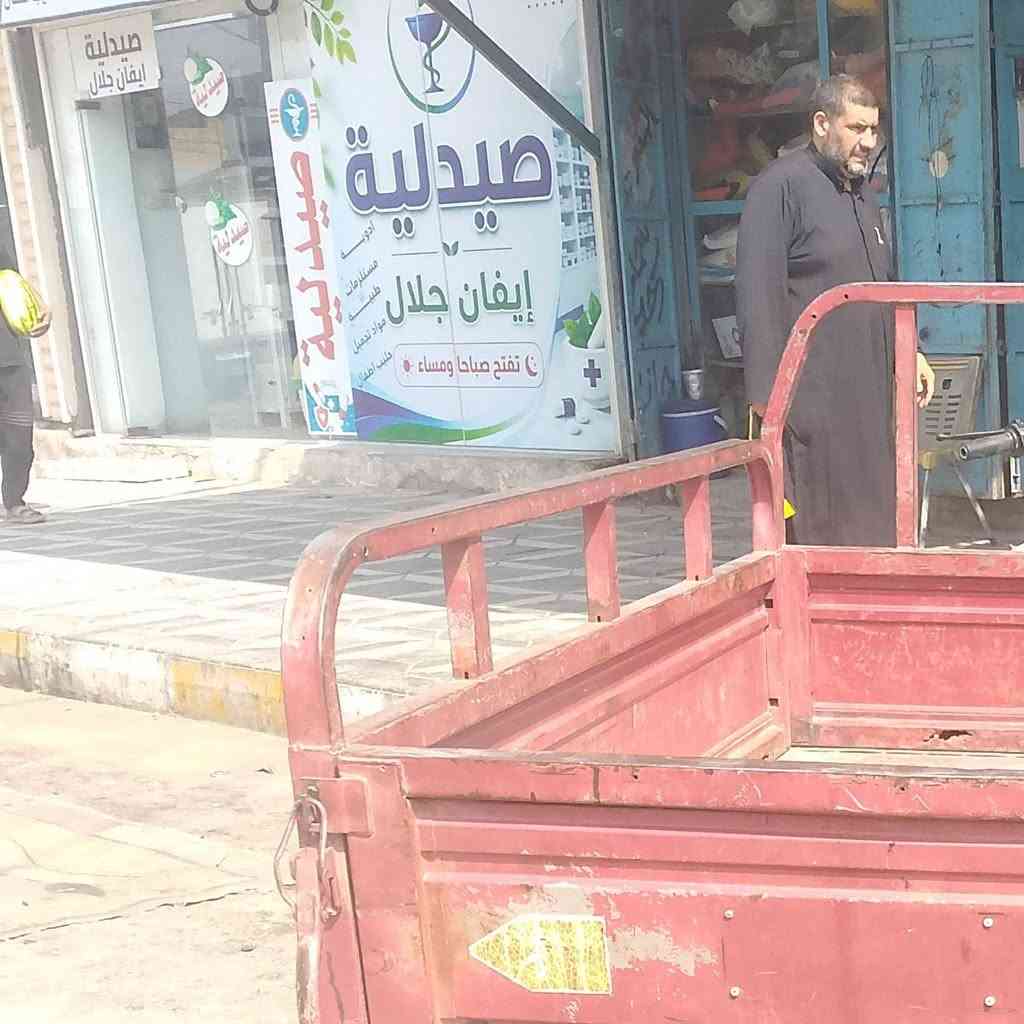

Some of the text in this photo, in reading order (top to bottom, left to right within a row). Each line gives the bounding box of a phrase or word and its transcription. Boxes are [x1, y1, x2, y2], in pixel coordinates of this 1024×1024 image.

[85, 31, 142, 66] صيدلية
[89, 69, 114, 95] جلال
[345, 122, 553, 237] صيدلية
[290, 151, 343, 367] صيدلية
[386, 269, 535, 325] إيفان جلال
[418, 354, 454, 378] ومساء
[493, 354, 521, 380] تفتح
